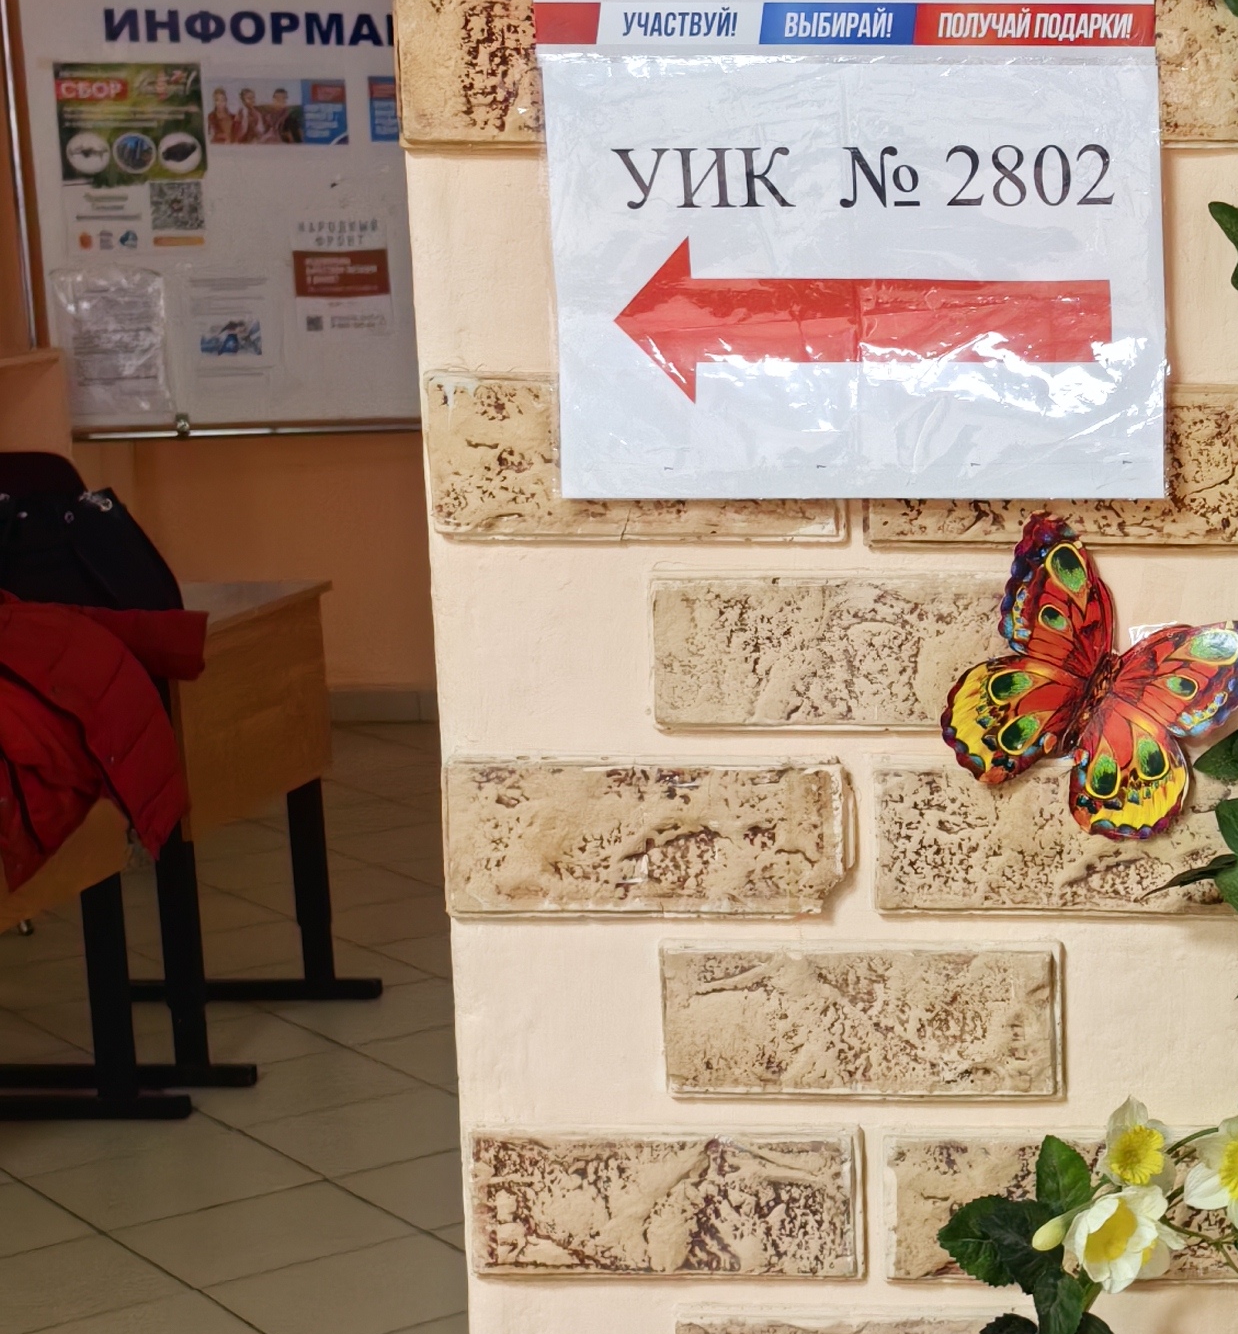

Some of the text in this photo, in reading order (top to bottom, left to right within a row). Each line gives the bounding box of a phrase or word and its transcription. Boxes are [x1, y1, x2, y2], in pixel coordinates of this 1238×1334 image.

[104, 8, 394, 47] ИНФОРМА
[623, 7, 1132, 40] УЧАСТВУЙ! ВЫБИРАЙ! ПОЛУЧАЙ ПОДАРКИ!
[61, 81, 122, 98] СБОР
[611, 144, 1115, 209] УИК № 2802
